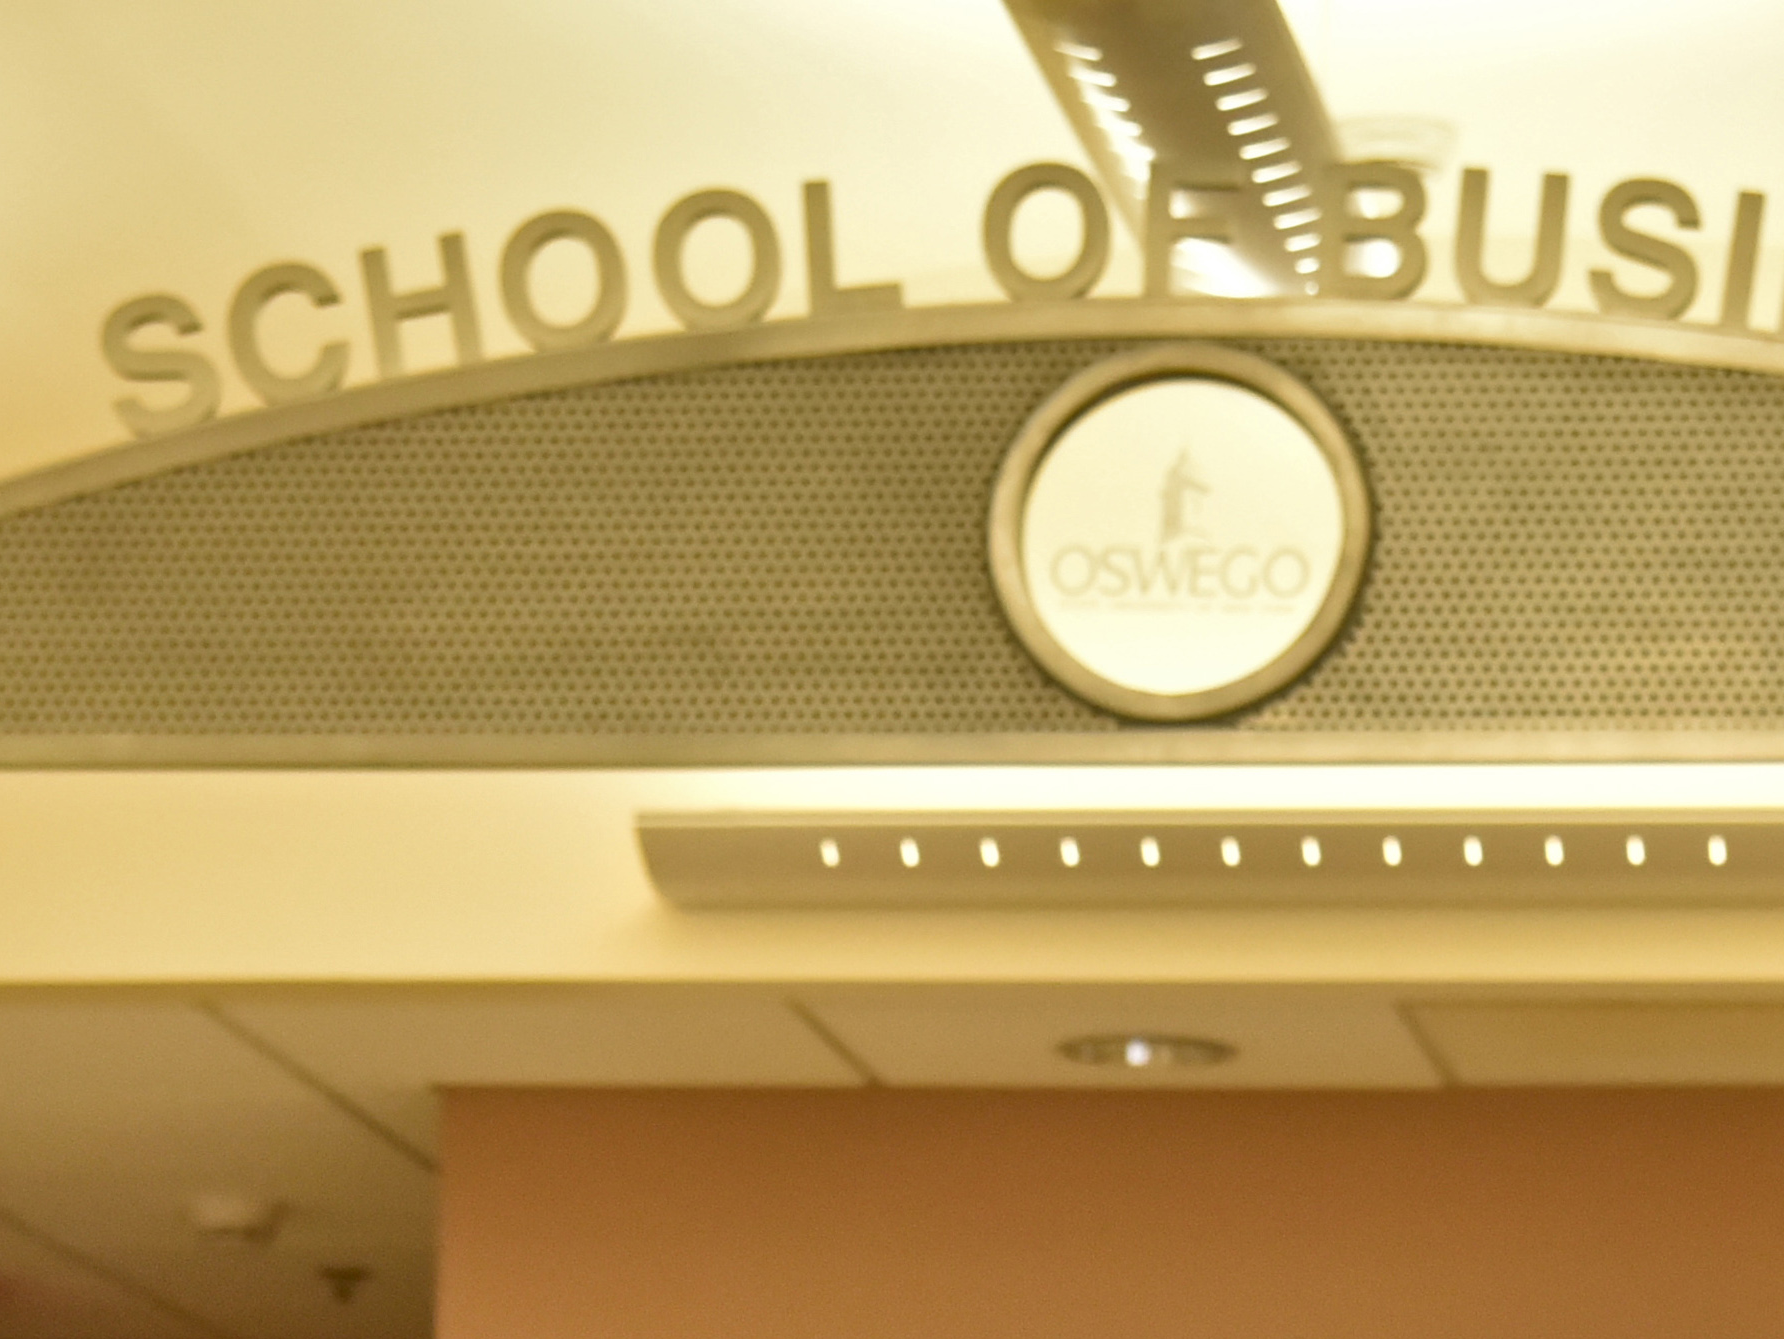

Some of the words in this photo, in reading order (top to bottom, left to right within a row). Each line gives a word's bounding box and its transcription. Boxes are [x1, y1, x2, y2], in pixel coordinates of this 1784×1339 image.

[99, 179, 905, 441] SCHOOL
[983, 160, 1243, 300] OF
[1049, 543, 1312, 599] OSWEGO
